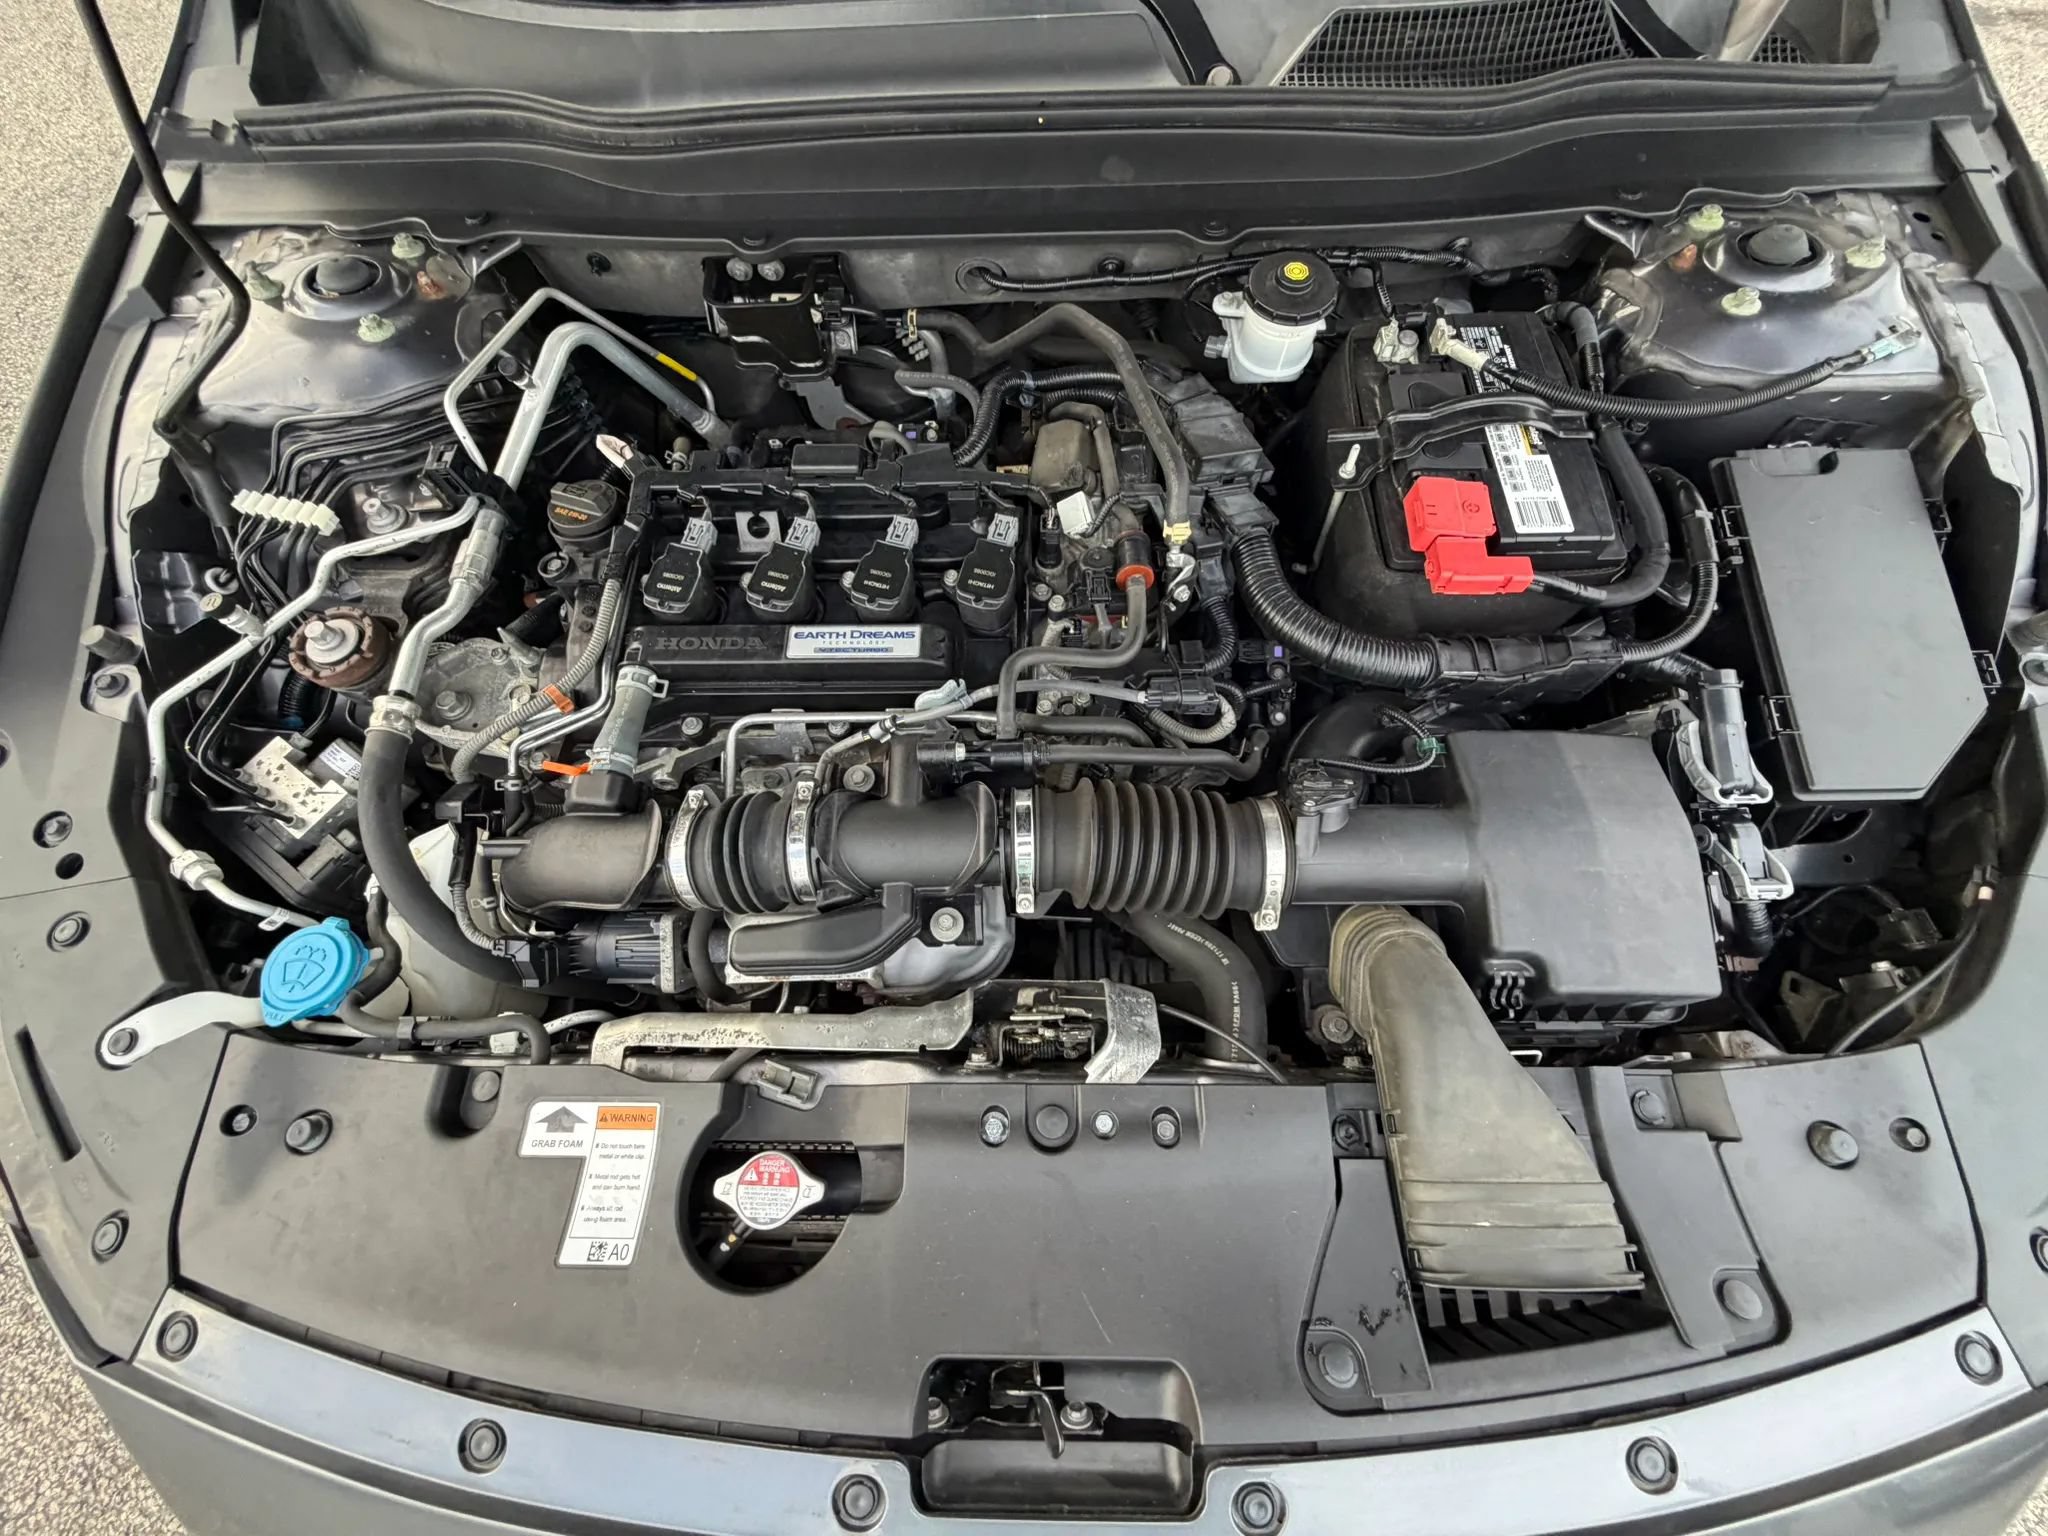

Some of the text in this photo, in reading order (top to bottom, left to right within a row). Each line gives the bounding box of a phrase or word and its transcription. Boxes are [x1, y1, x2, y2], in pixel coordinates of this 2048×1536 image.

[863, 580, 890, 590] HITACHI
[967, 579, 995, 590] HITACHI
[793, 631, 847, 640] EARTH
[655, 636, 767, 650] HONDA
[610, 1113, 654, 1123] WARNING
[531, 1139, 584, 1148] GRAB FOAM
[607, 1243, 629, 1261] A0
